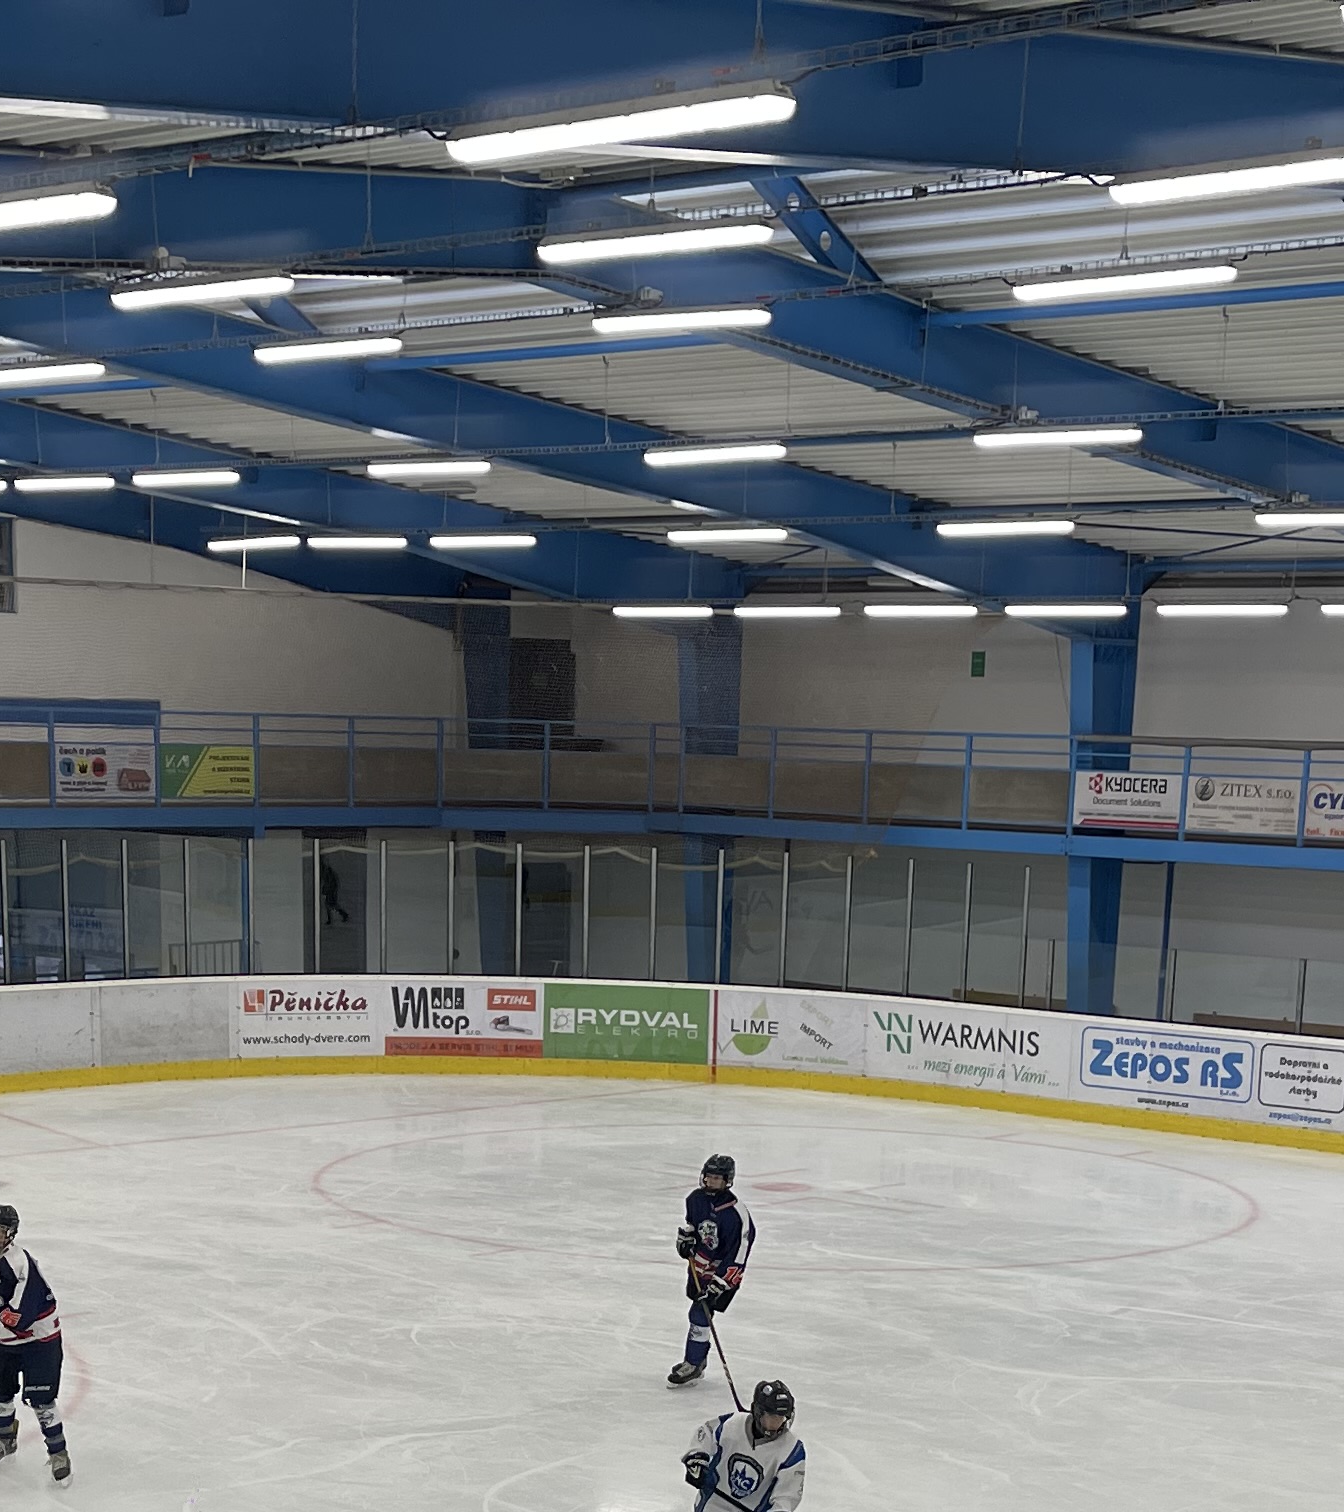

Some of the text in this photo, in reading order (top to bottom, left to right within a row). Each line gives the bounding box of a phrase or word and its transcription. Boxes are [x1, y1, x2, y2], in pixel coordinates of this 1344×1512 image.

[1220, 783, 1295, 800] ZITEX s.r.o.
[1092, 796, 1162, 808] Document Solutions
[269, 989, 368, 1011] Pěnička
[492, 995, 531, 1005] STIHL
[577, 1008, 698, 1029] RYDVAL
[577, 1025, 698, 1039] ELEKTRO
[730, 1018, 779, 1035] LIME
[242, 1033, 370, 1045] www.schody-dvere.com
[799, 1022, 834, 1051] IMPORT
[918, 1019, 1040, 1057] WARMNIS
[1115, 1037, 1147, 1049] stavby
[923, 1059, 952, 1073] mezi
[1090, 1038, 1190, 1084] ZEPOS
[1279, 1057, 1321, 1070] Dopravní
